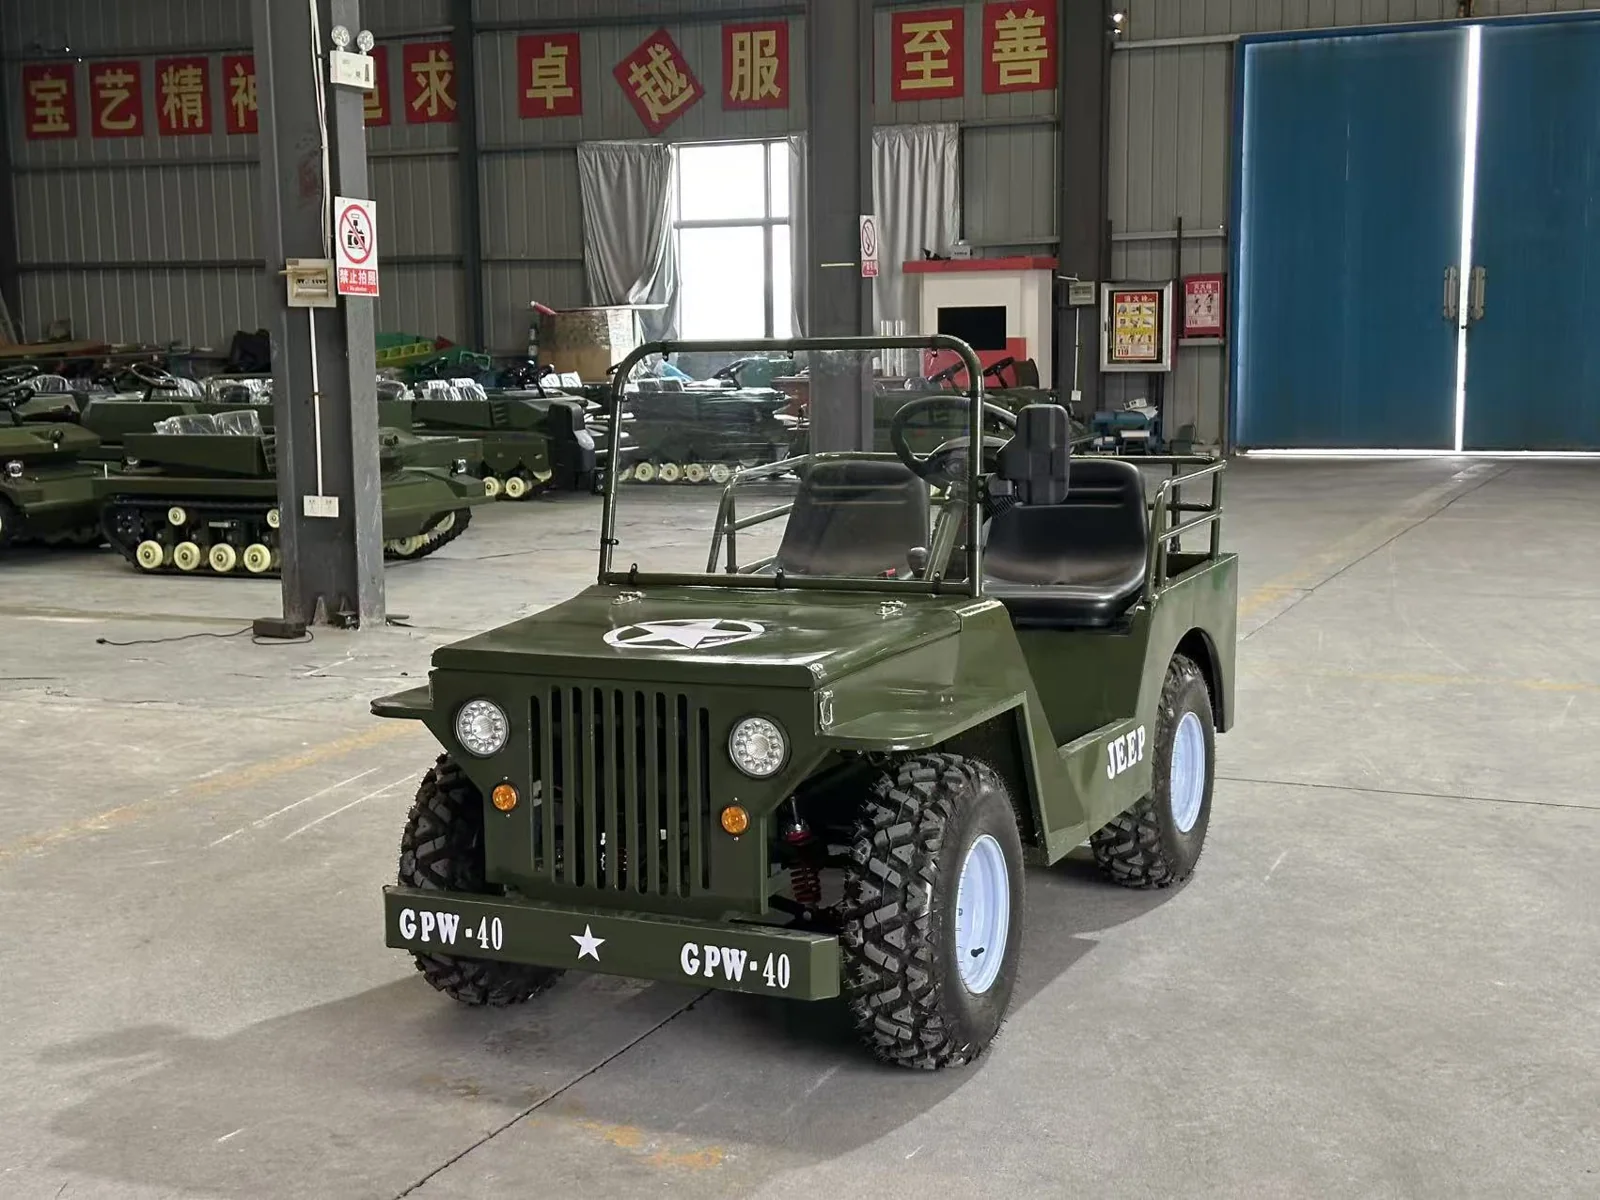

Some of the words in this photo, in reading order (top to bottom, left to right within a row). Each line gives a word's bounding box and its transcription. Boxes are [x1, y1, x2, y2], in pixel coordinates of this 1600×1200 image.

[339, 268, 377, 286] 禁止拍照
[1107, 725, 1146, 780] JEEP
